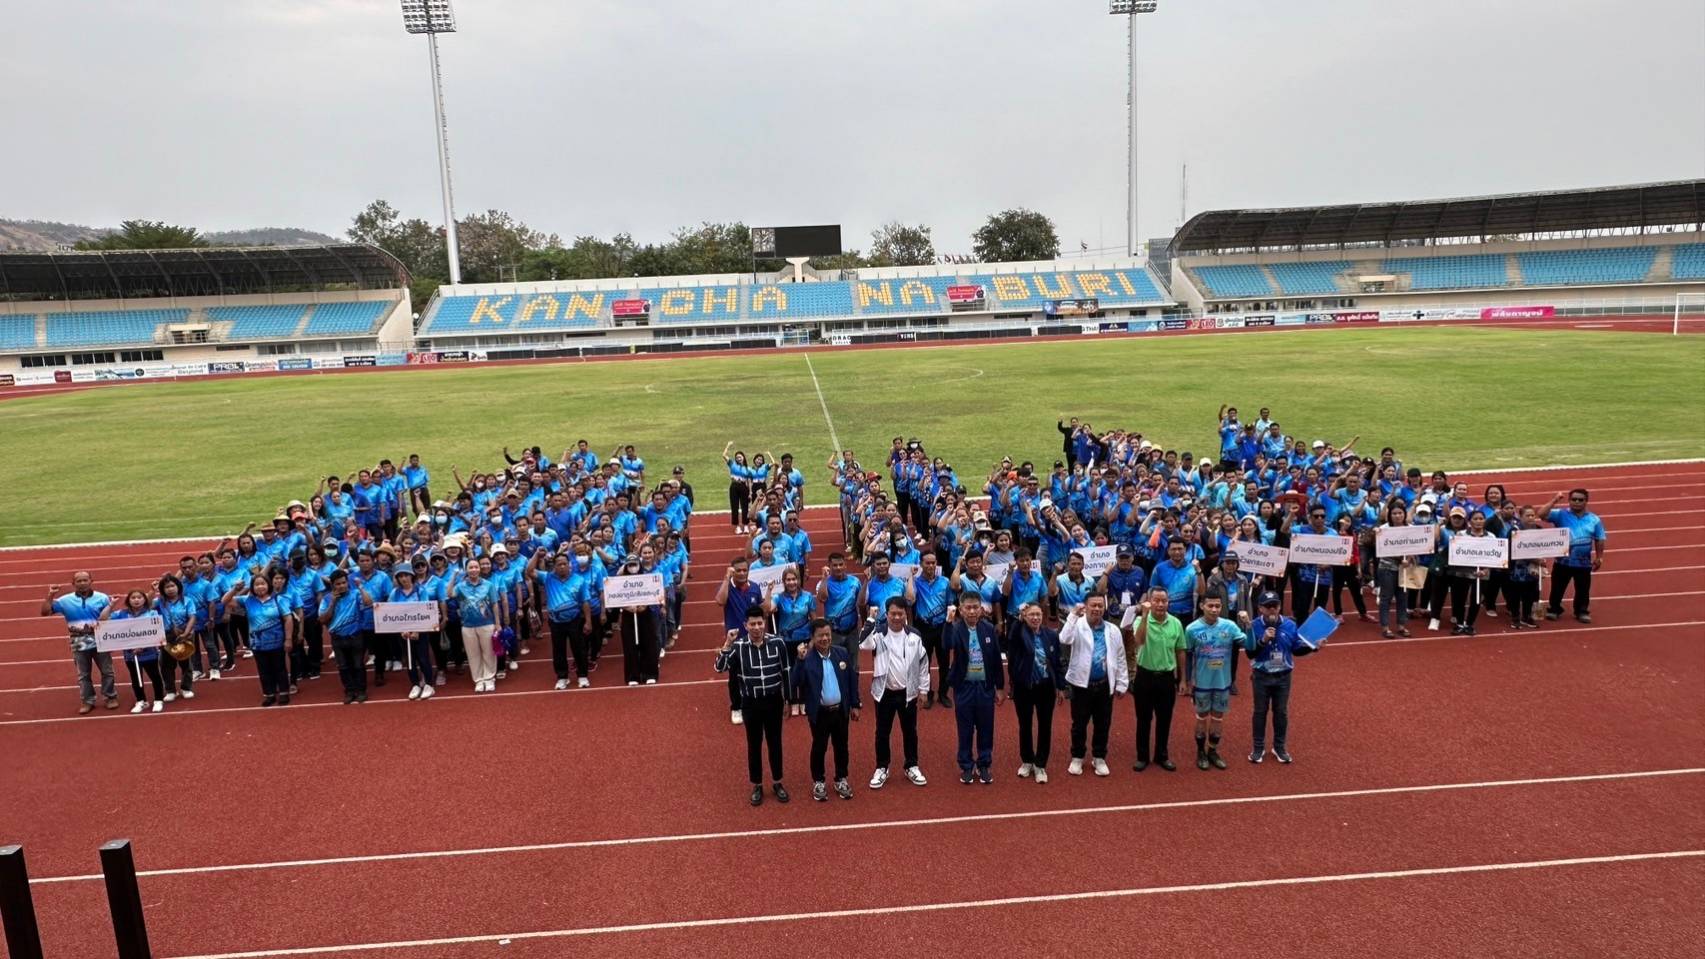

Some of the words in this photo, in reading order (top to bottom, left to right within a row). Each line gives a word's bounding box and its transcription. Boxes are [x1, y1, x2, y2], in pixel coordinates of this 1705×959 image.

[469, 293, 604, 323] KAN
[660, 286, 787, 316] CHA
[992, 272, 1136, 300] BURI
[1090, 551, 1111, 559] อำเภอ
[1248, 548, 1269, 557] อำเภอ
[1455, 547, 1502, 558] อำเภอเลาขวัญ
[1238, 555, 1275, 568] ้วยกระเจา
[623, 580, 644, 589] อำเภอ
[382, 613, 431, 622] อำเภอไทรโยค
